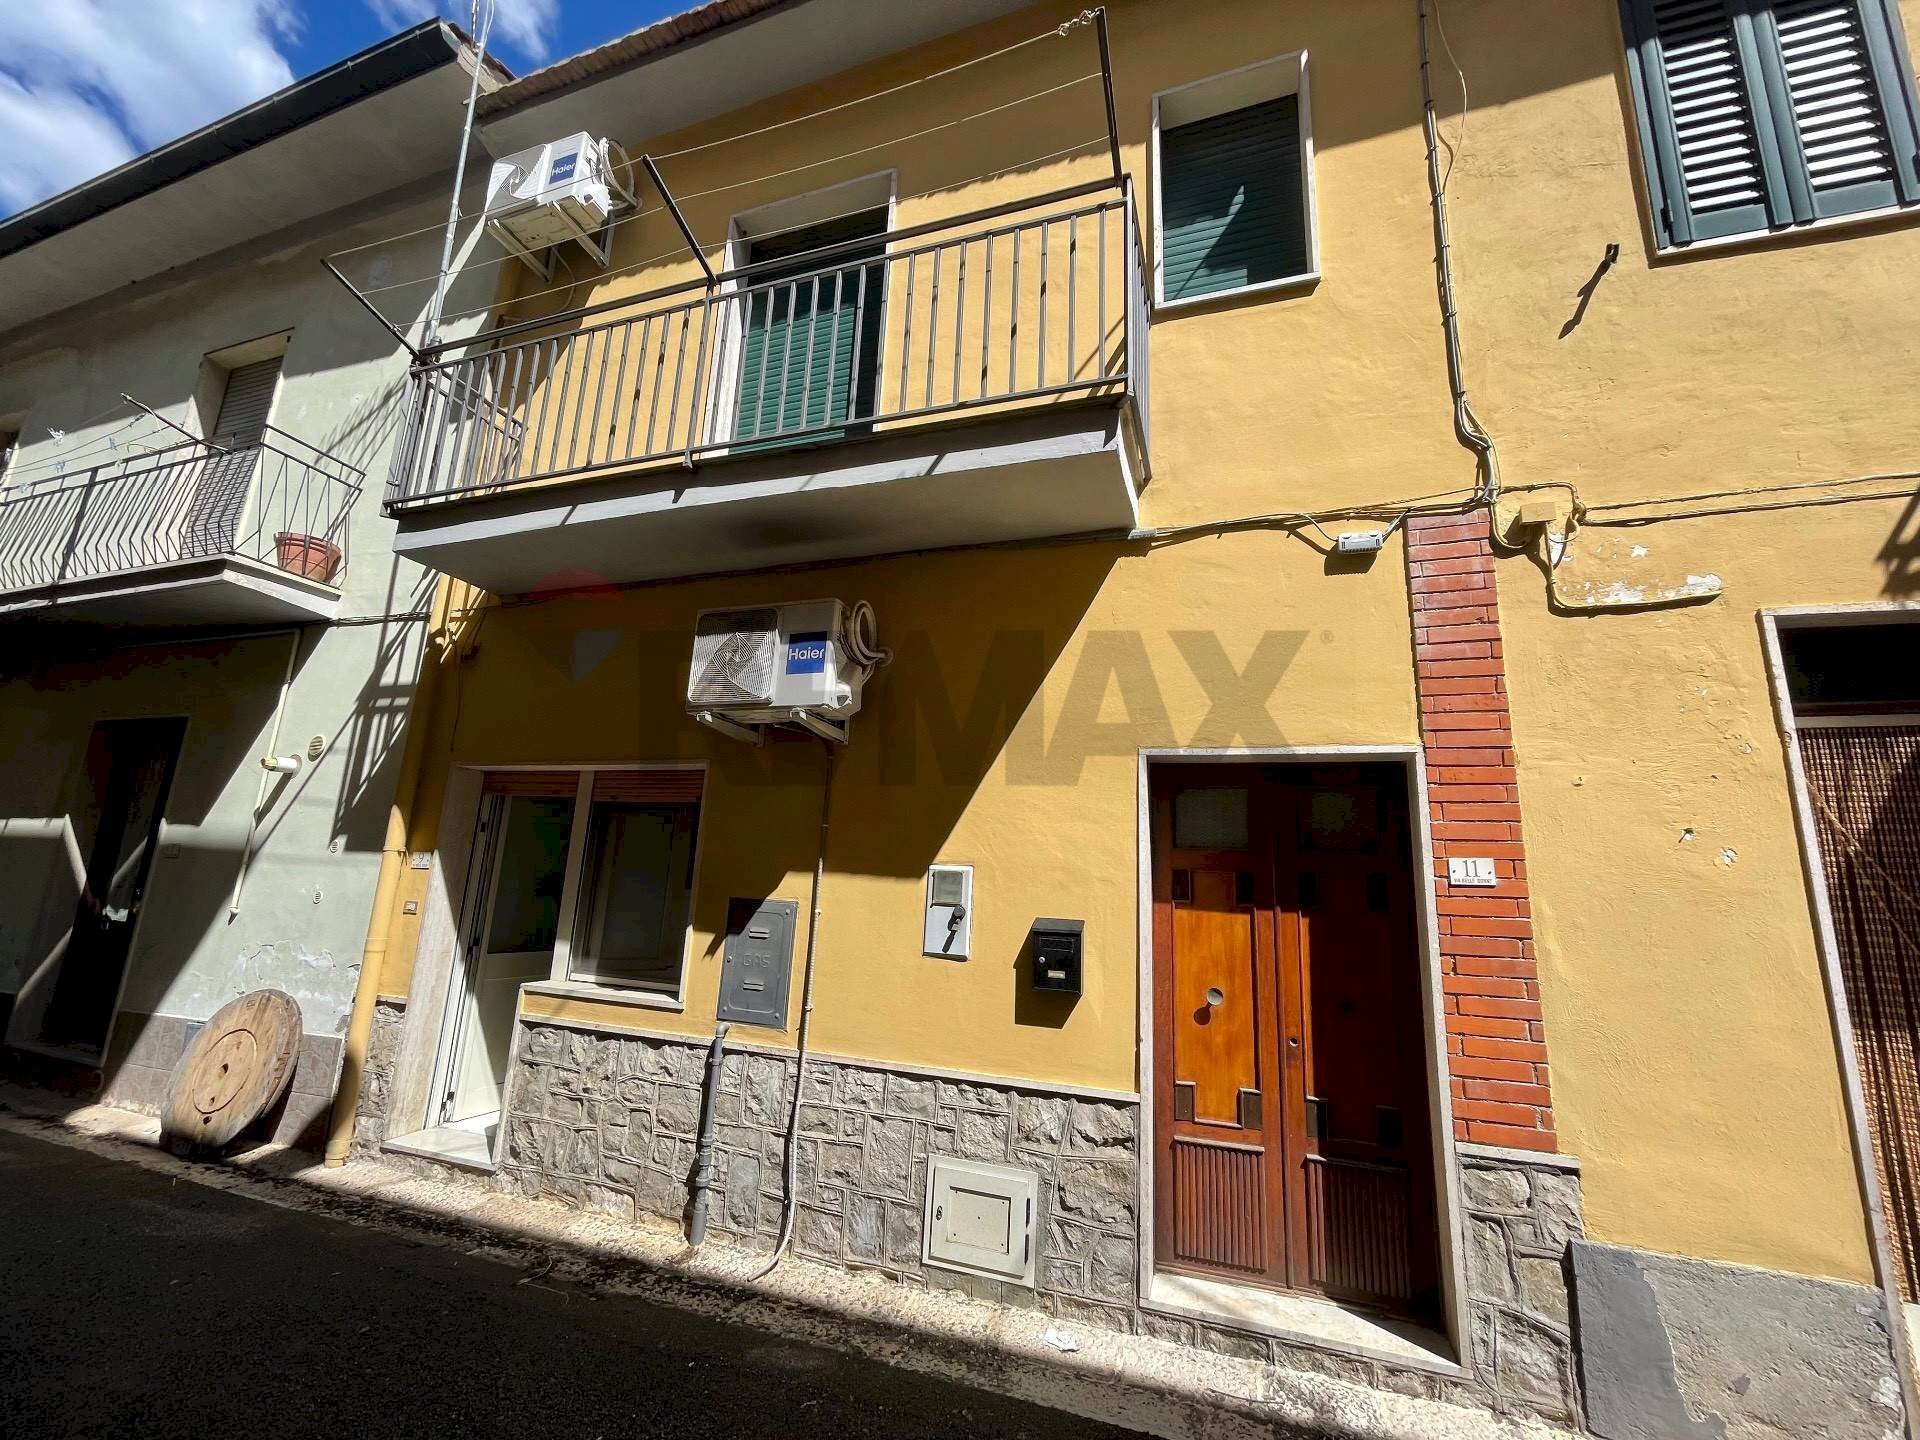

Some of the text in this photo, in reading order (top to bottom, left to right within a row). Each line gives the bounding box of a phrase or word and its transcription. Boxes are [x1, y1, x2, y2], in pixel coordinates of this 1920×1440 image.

[551, 162, 576, 177] Haier
[788, 646, 825, 661] Haier
[1462, 860, 1480, 878] 11
